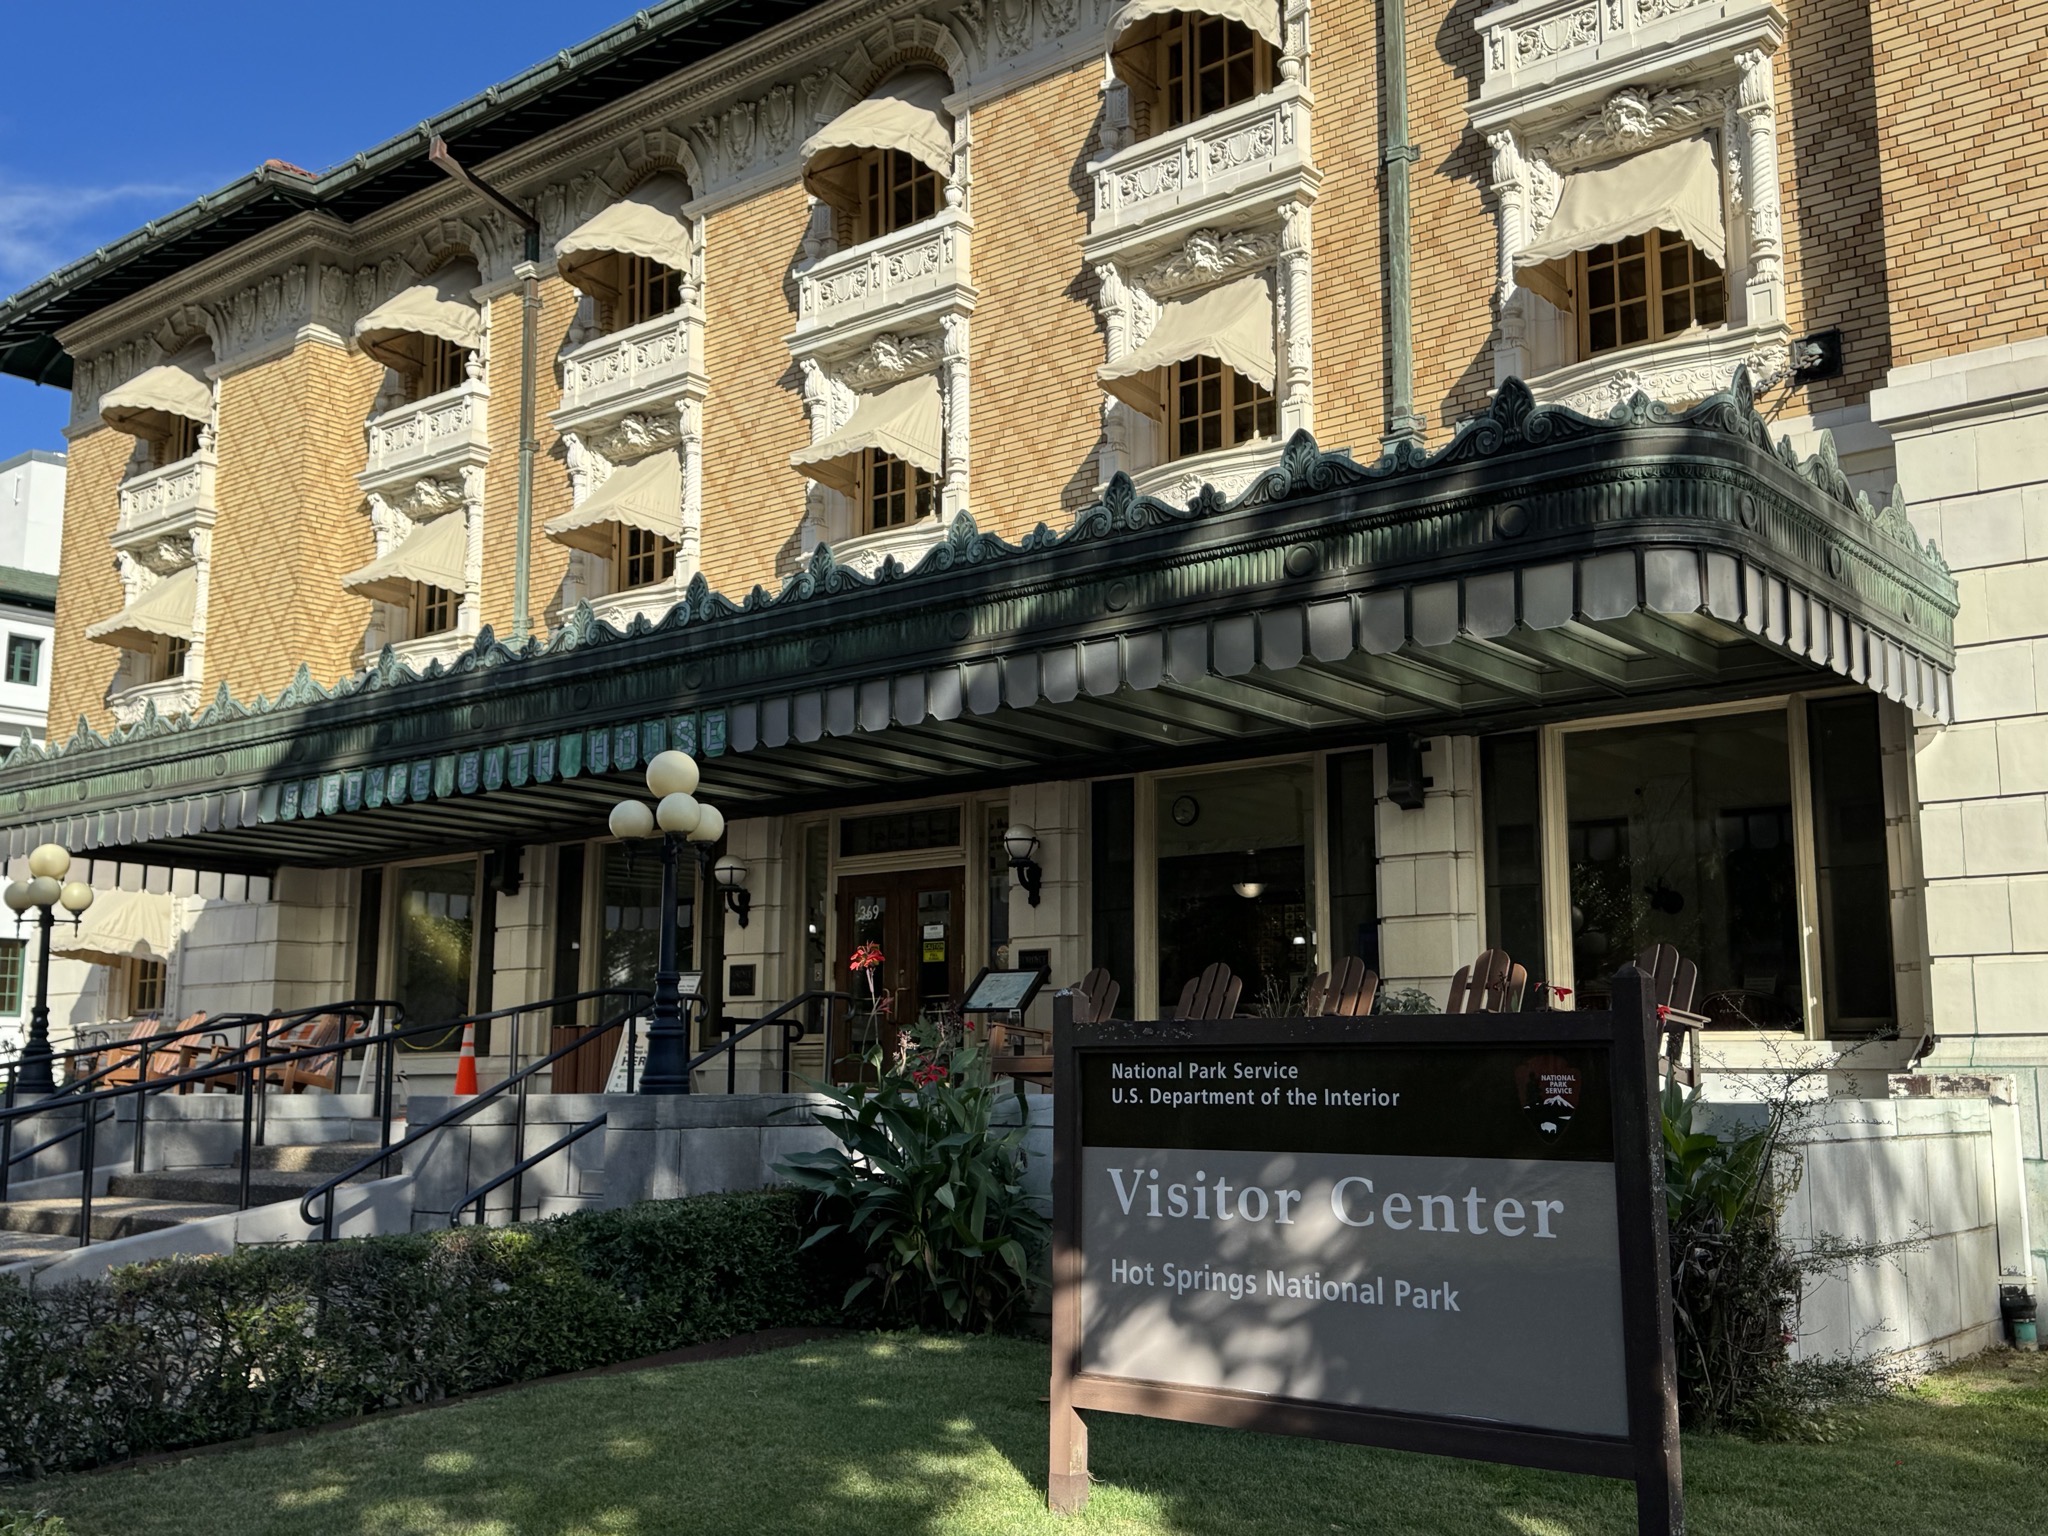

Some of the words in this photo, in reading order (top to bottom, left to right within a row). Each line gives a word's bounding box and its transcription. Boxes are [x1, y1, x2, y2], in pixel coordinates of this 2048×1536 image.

[462, 742, 554, 788] BATH
[590, 714, 724, 768] HOUSE
[859, 904, 879, 920] 369
[621, 1056, 646, 1066] HER
[1112, 1062, 1182, 1079] National
[1189, 1062, 1227, 1079] Park
[1233, 1062, 1298, 1079] Service
[1112, 1087, 1143, 1104] U.S.
[1150, 1087, 1255, 1108] Department
[1261, 1087, 1280, 1105] of
[1286, 1087, 1317, 1105] the
[1325, 1087, 1400, 1106] Interior
[1107, 1168, 1301, 1225] Visitor
[1330, 1176, 1564, 1239] Center
[1111, 1259, 1154, 1287] Hot
[1163, 1262, 1257, 1300] Springs
[1266, 1270, 1384, 1306] National
[1395, 1279, 1460, 1312] Park
